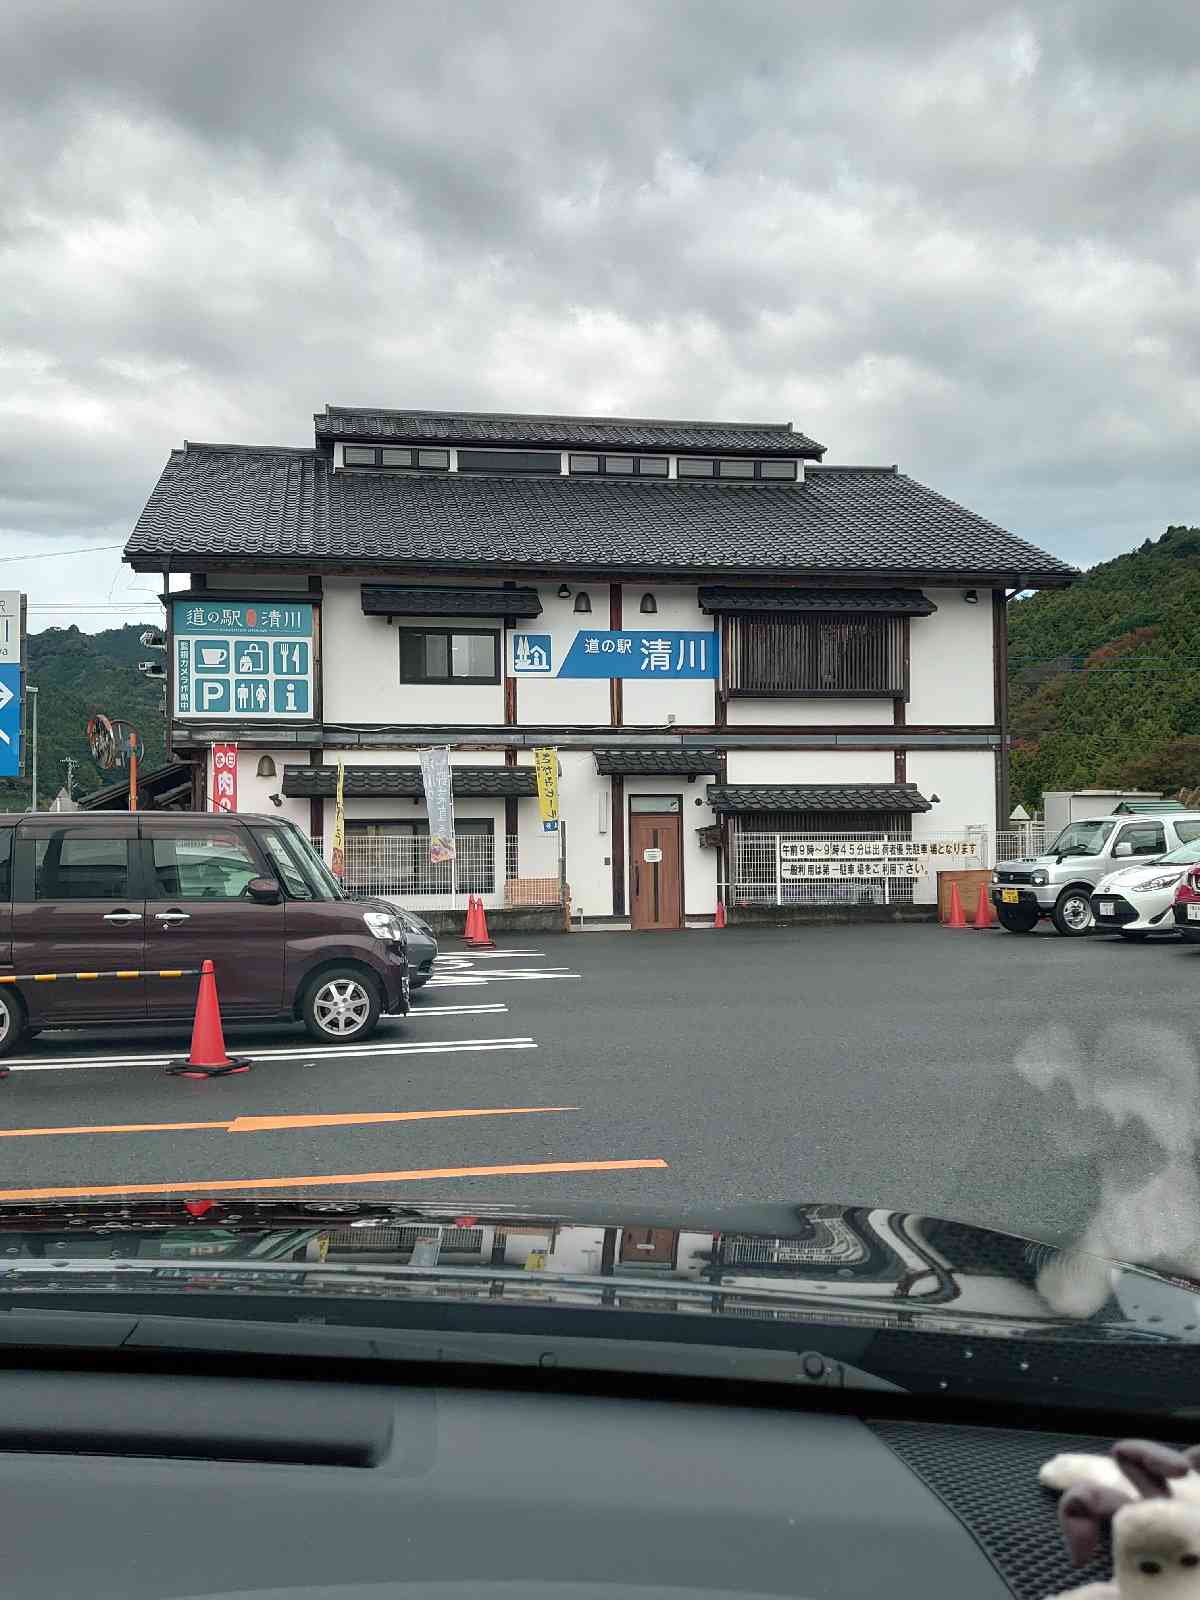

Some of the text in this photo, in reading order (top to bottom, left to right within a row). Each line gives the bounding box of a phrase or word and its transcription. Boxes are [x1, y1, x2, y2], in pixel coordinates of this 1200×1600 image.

[185, 608, 302, 628] 道の駅 清川
[584, 638, 707, 671] 道の駅 清川
[203, 682, 224, 710] P
